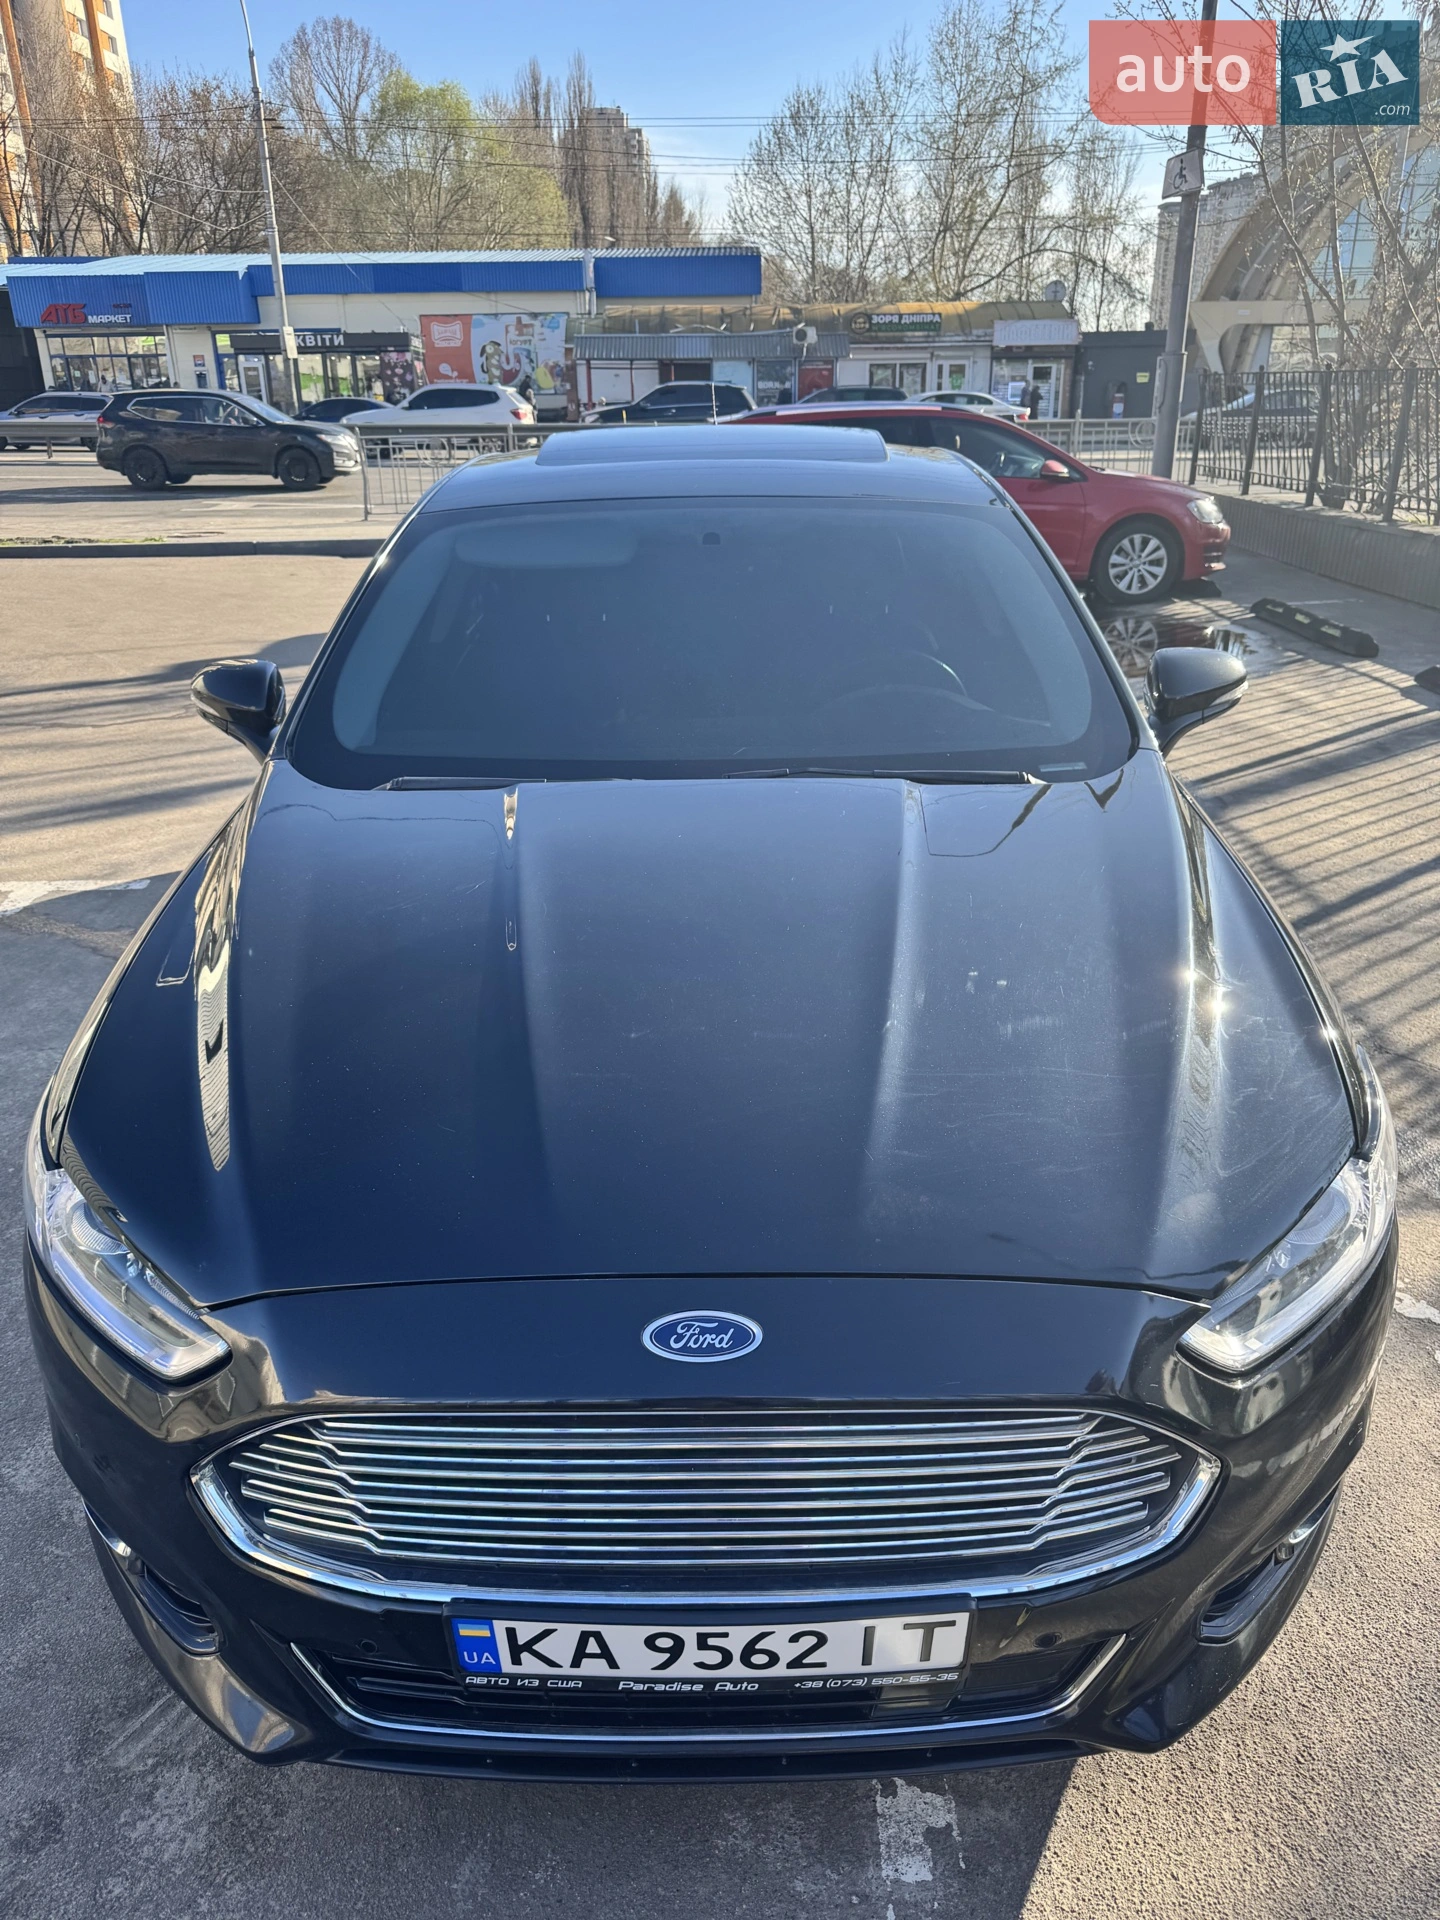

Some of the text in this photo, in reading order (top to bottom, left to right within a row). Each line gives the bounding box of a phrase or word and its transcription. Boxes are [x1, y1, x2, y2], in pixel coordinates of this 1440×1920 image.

[41, 303, 132, 324] АТБ МАРКЕТ
[871, 314, 941, 325] ЗОРЯ ДНІПРА
[295, 334, 345, 348] КВІТИ
[669, 1321, 735, 1349] Ford
[463, 1619, 957, 1671] UA KA 9562 IT
[465, 1676, 583, 1688] АВТО ИЗ США
[618, 1681, 760, 1692] Paradise Auto
[794, 1672, 960, 1689] +38 (073) 550-55-35
